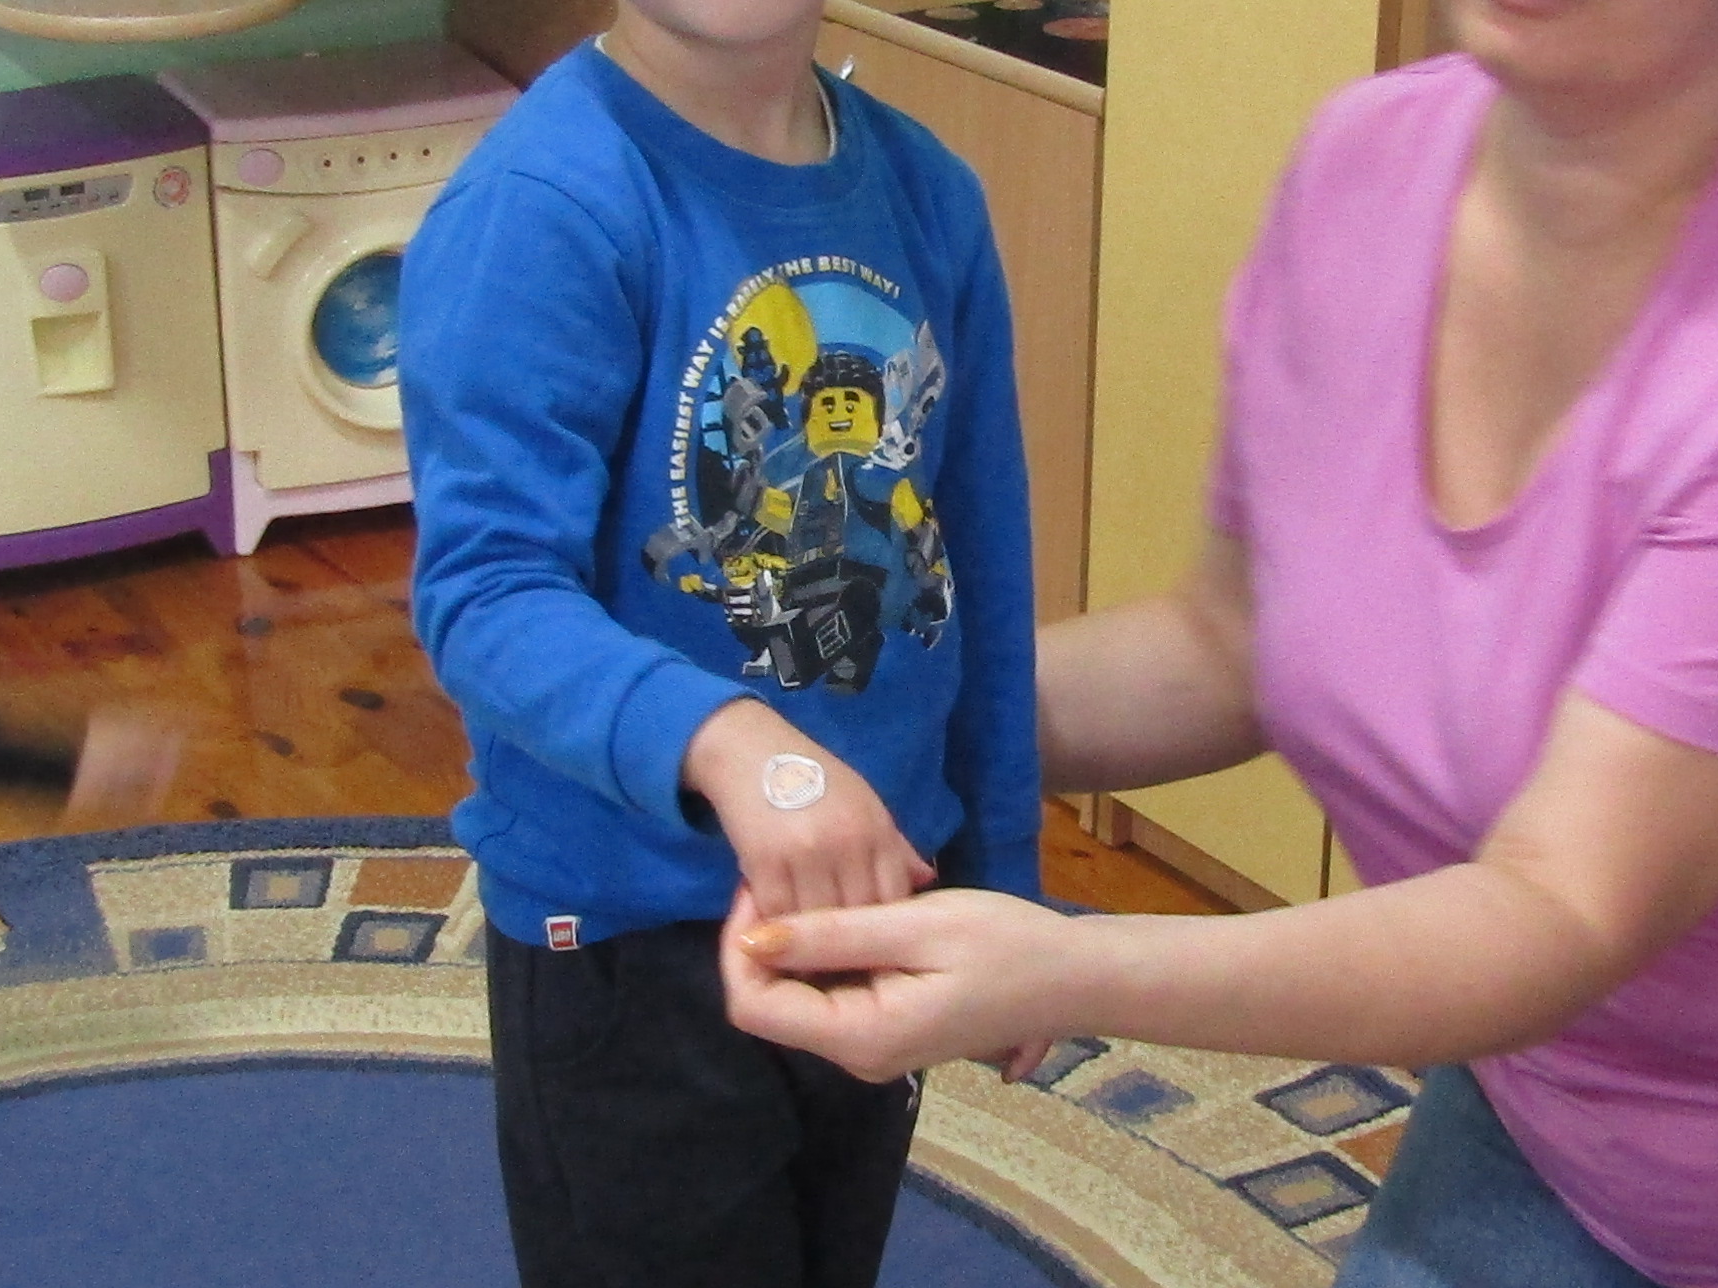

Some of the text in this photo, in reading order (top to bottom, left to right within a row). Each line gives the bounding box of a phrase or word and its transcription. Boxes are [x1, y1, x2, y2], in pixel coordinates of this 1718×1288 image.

[683, 339, 714, 389] WAY
[707, 316, 731, 340] IS
[817, 255, 857, 276] BEST
